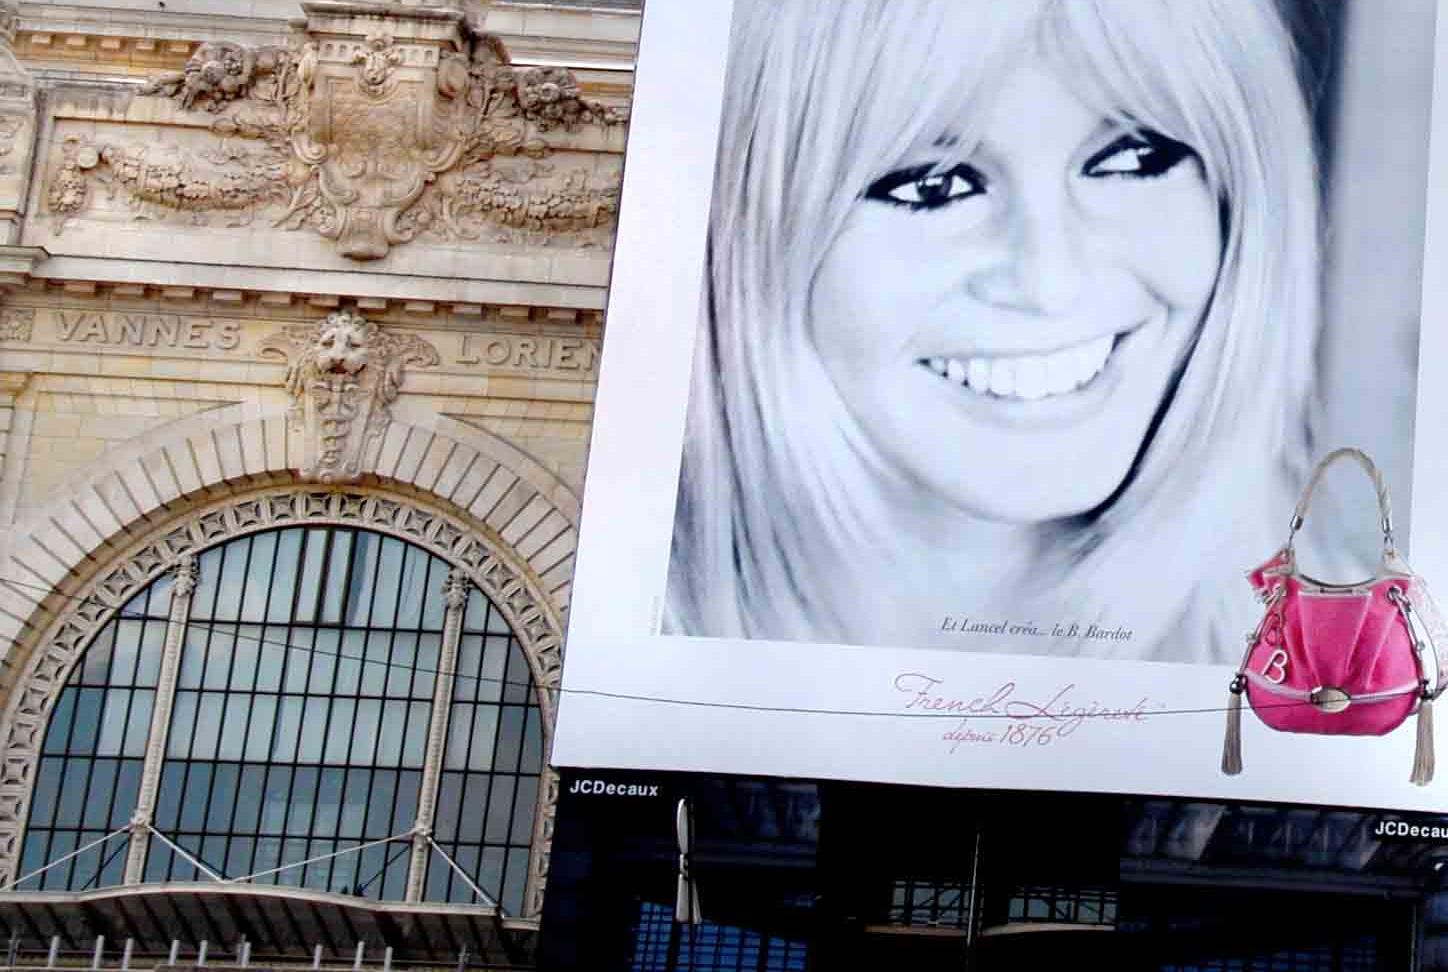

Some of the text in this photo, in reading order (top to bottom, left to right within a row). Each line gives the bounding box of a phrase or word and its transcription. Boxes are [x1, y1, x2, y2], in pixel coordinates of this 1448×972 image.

[55, 312, 241, 350] VANNES
[941, 617, 957, 631] Et
[960, 618, 1008, 634] Lancel
[1085, 624, 1132, 641] Bardot
[894, 672, 1016, 714] French
[999, 722, 1052, 747] 1876
[570, 779, 659, 796] JCDecaux
